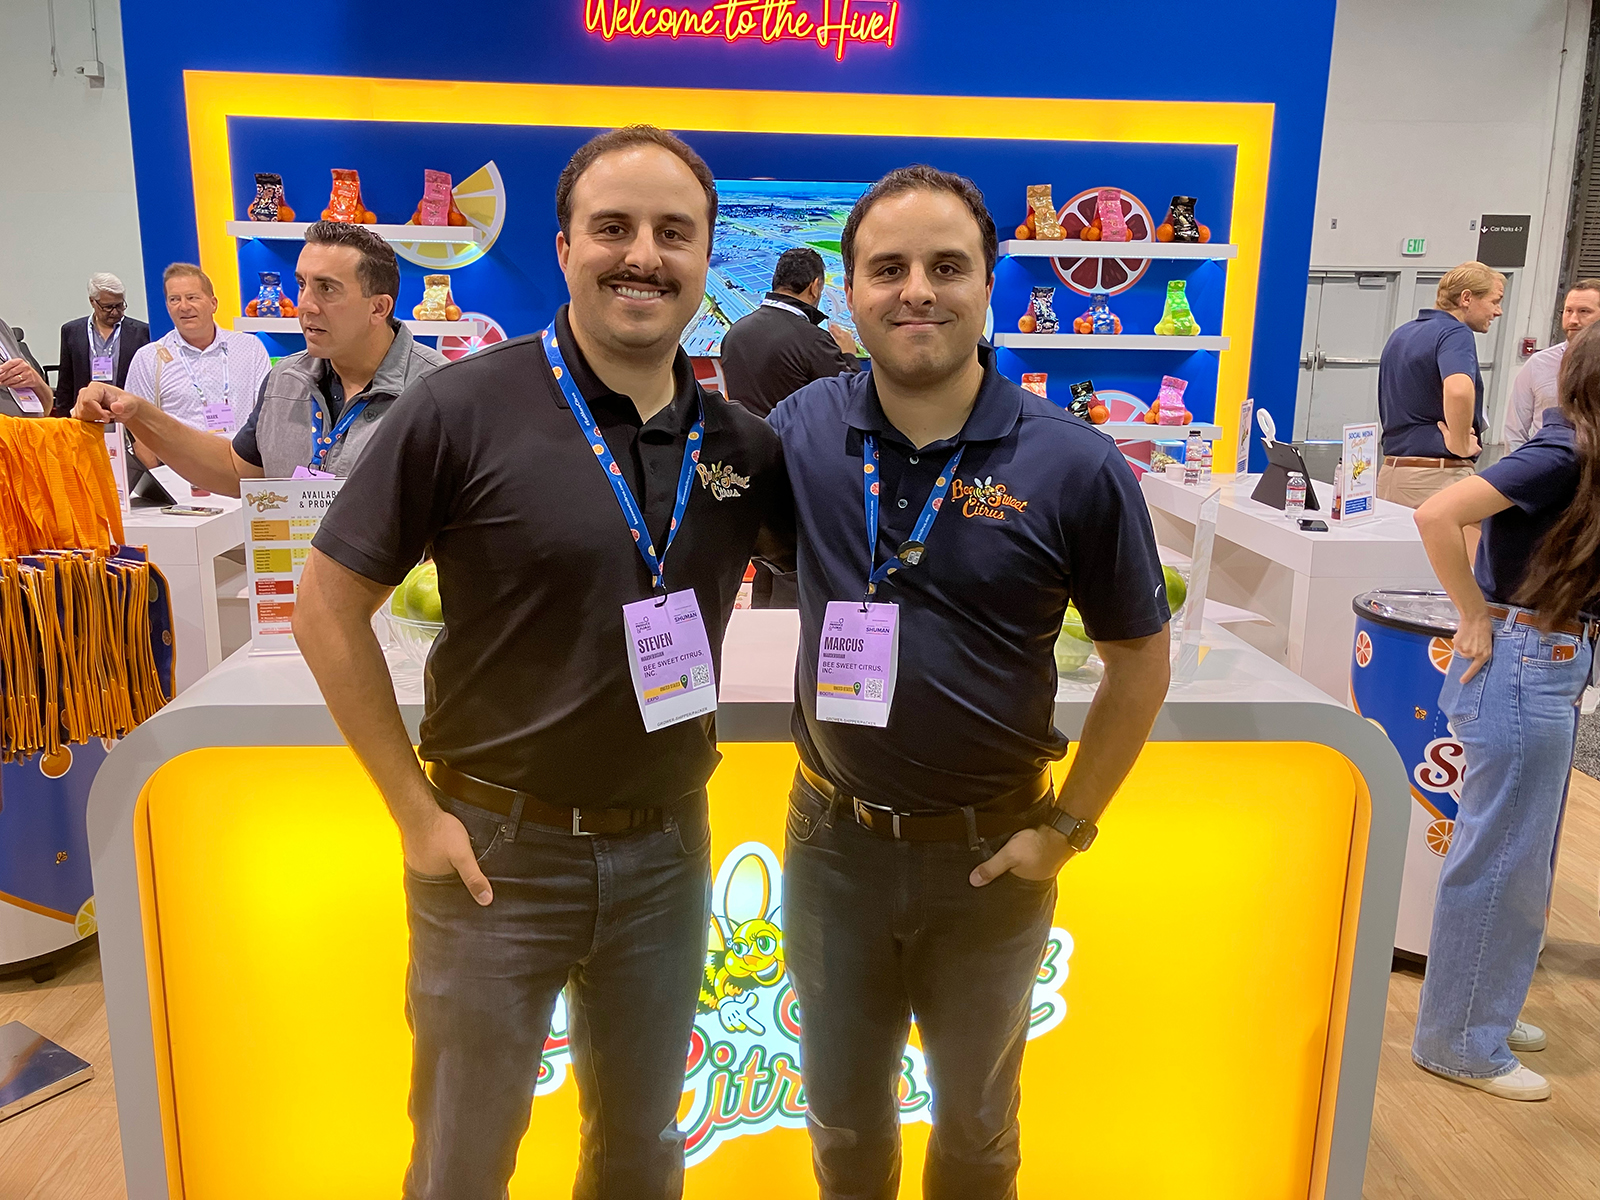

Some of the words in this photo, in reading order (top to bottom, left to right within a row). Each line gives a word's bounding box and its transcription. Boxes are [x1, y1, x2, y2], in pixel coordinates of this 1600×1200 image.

[585, 0, 718, 40] Welcome
[714, 0, 758, 42] to
[752, 0, 814, 43] the
[816, 0, 899, 61] Hive!
[1407, 239, 1426, 253] EXIT
[301, 490, 340, 500] AVAILAB
[951, 478, 975, 503] Bee
[987, 483, 1029, 514] Sweet
[299, 500, 305, 509] &
[962, 497, 1006, 520] Citrus
[866, 626, 890, 634] SHUMAN
[637, 631, 673, 654] STEVEN
[824, 636, 864, 652] MARCUS
[643, 662, 657, 673] BEE
[657, 655, 679, 669] SWEET
[822, 660, 835, 669] BEE
[835, 662, 858, 671] SWEET
[643, 669, 658, 679] INC.
[821, 667, 835, 675] INC.
[646, 695, 660, 703] EXPO
